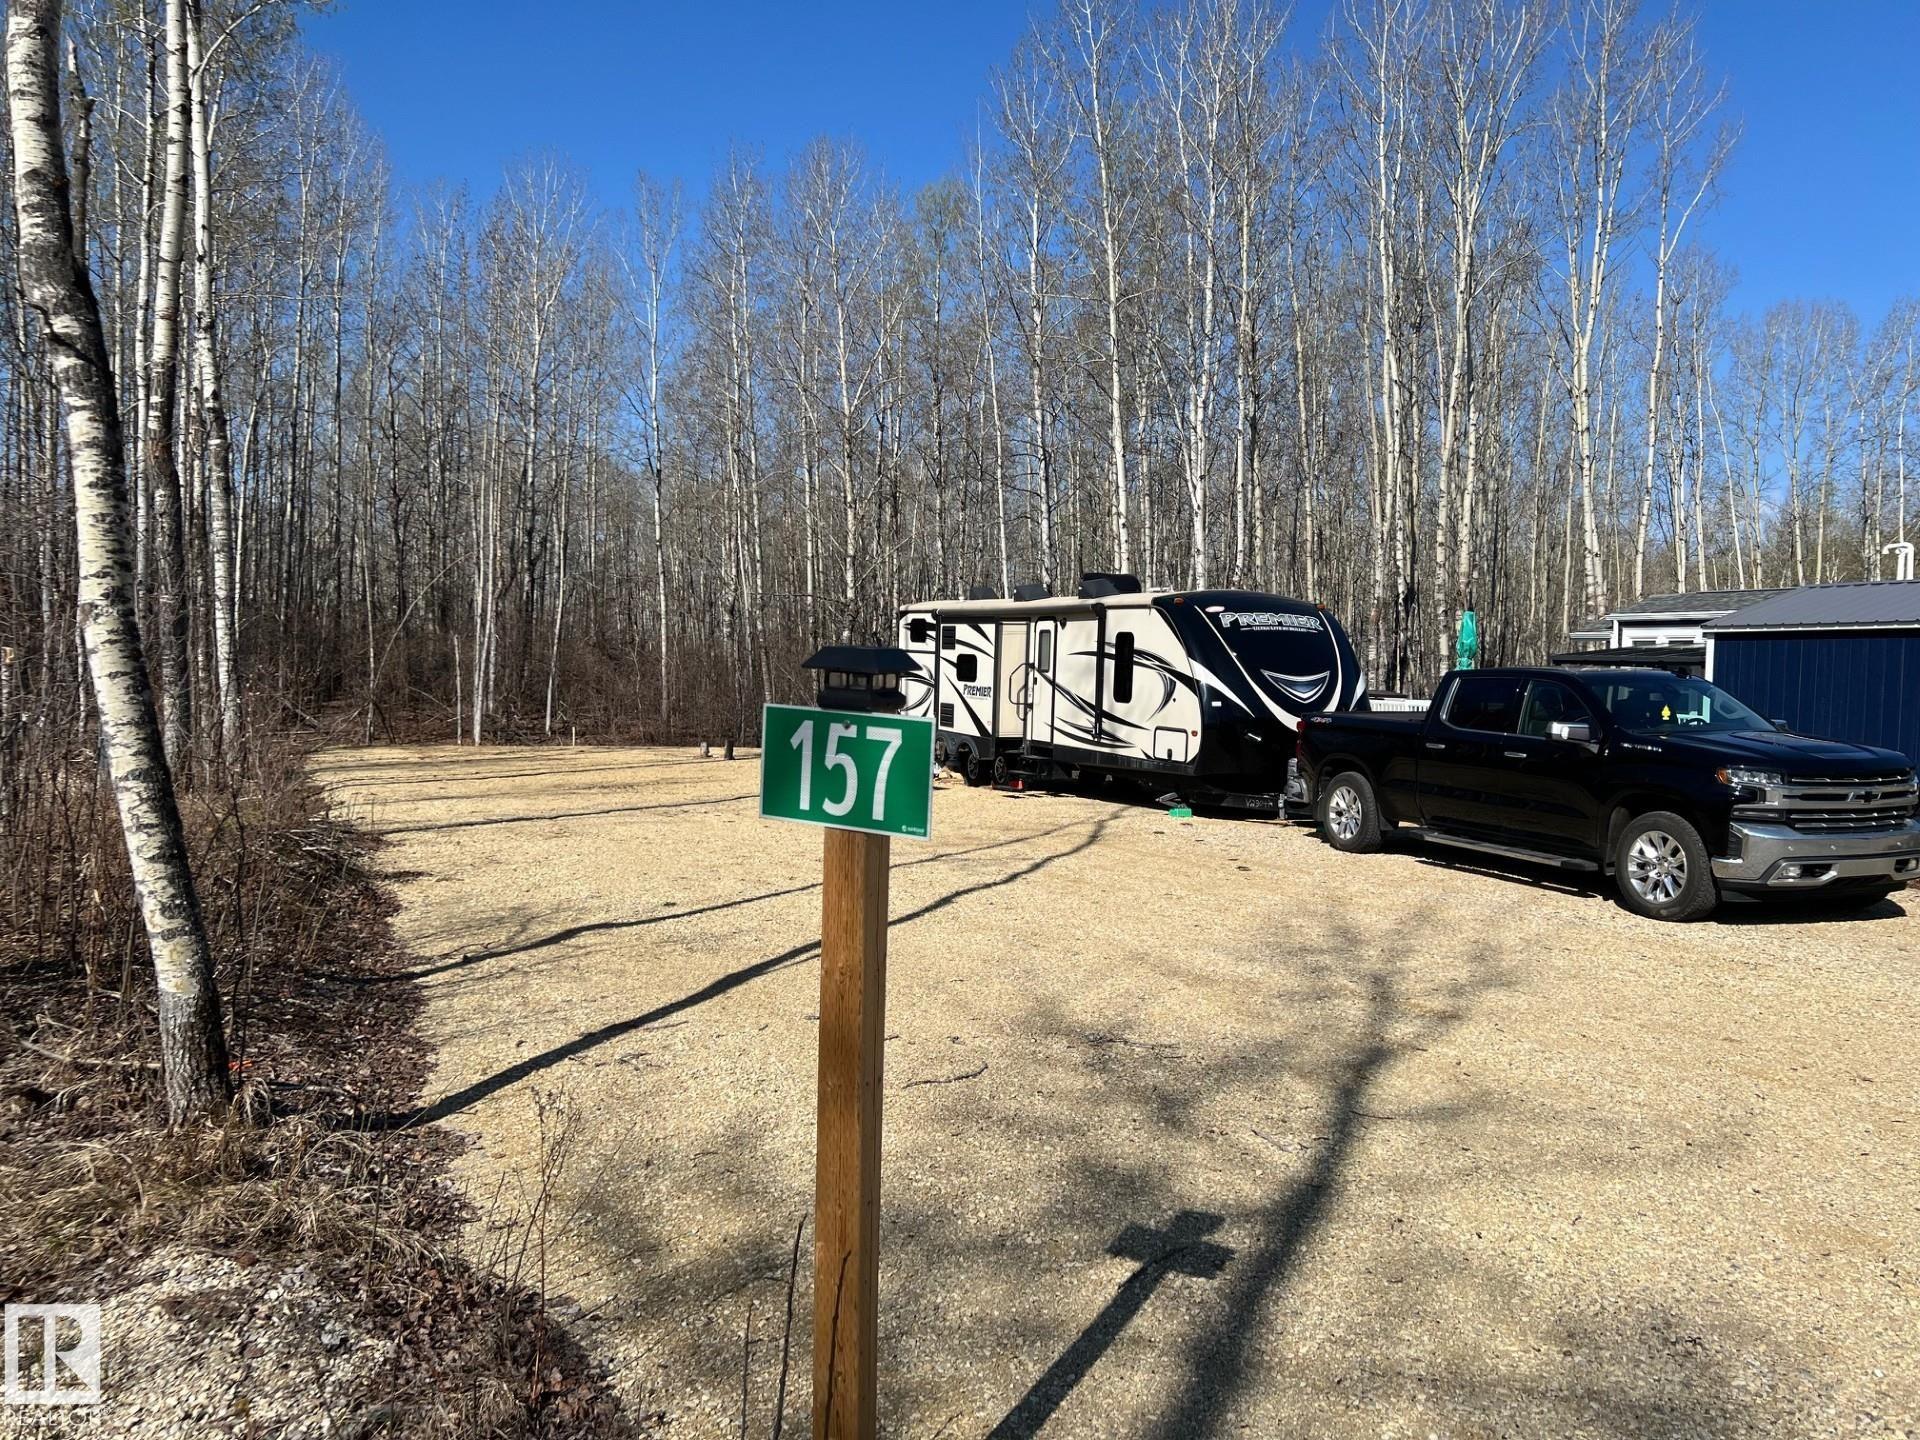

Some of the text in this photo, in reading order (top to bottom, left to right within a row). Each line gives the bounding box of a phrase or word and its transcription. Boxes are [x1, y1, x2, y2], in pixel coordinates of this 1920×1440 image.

[1218, 612, 1324, 631] PREMIER
[962, 683, 992, 698] PREMIER
[790, 719, 903, 822] 157
